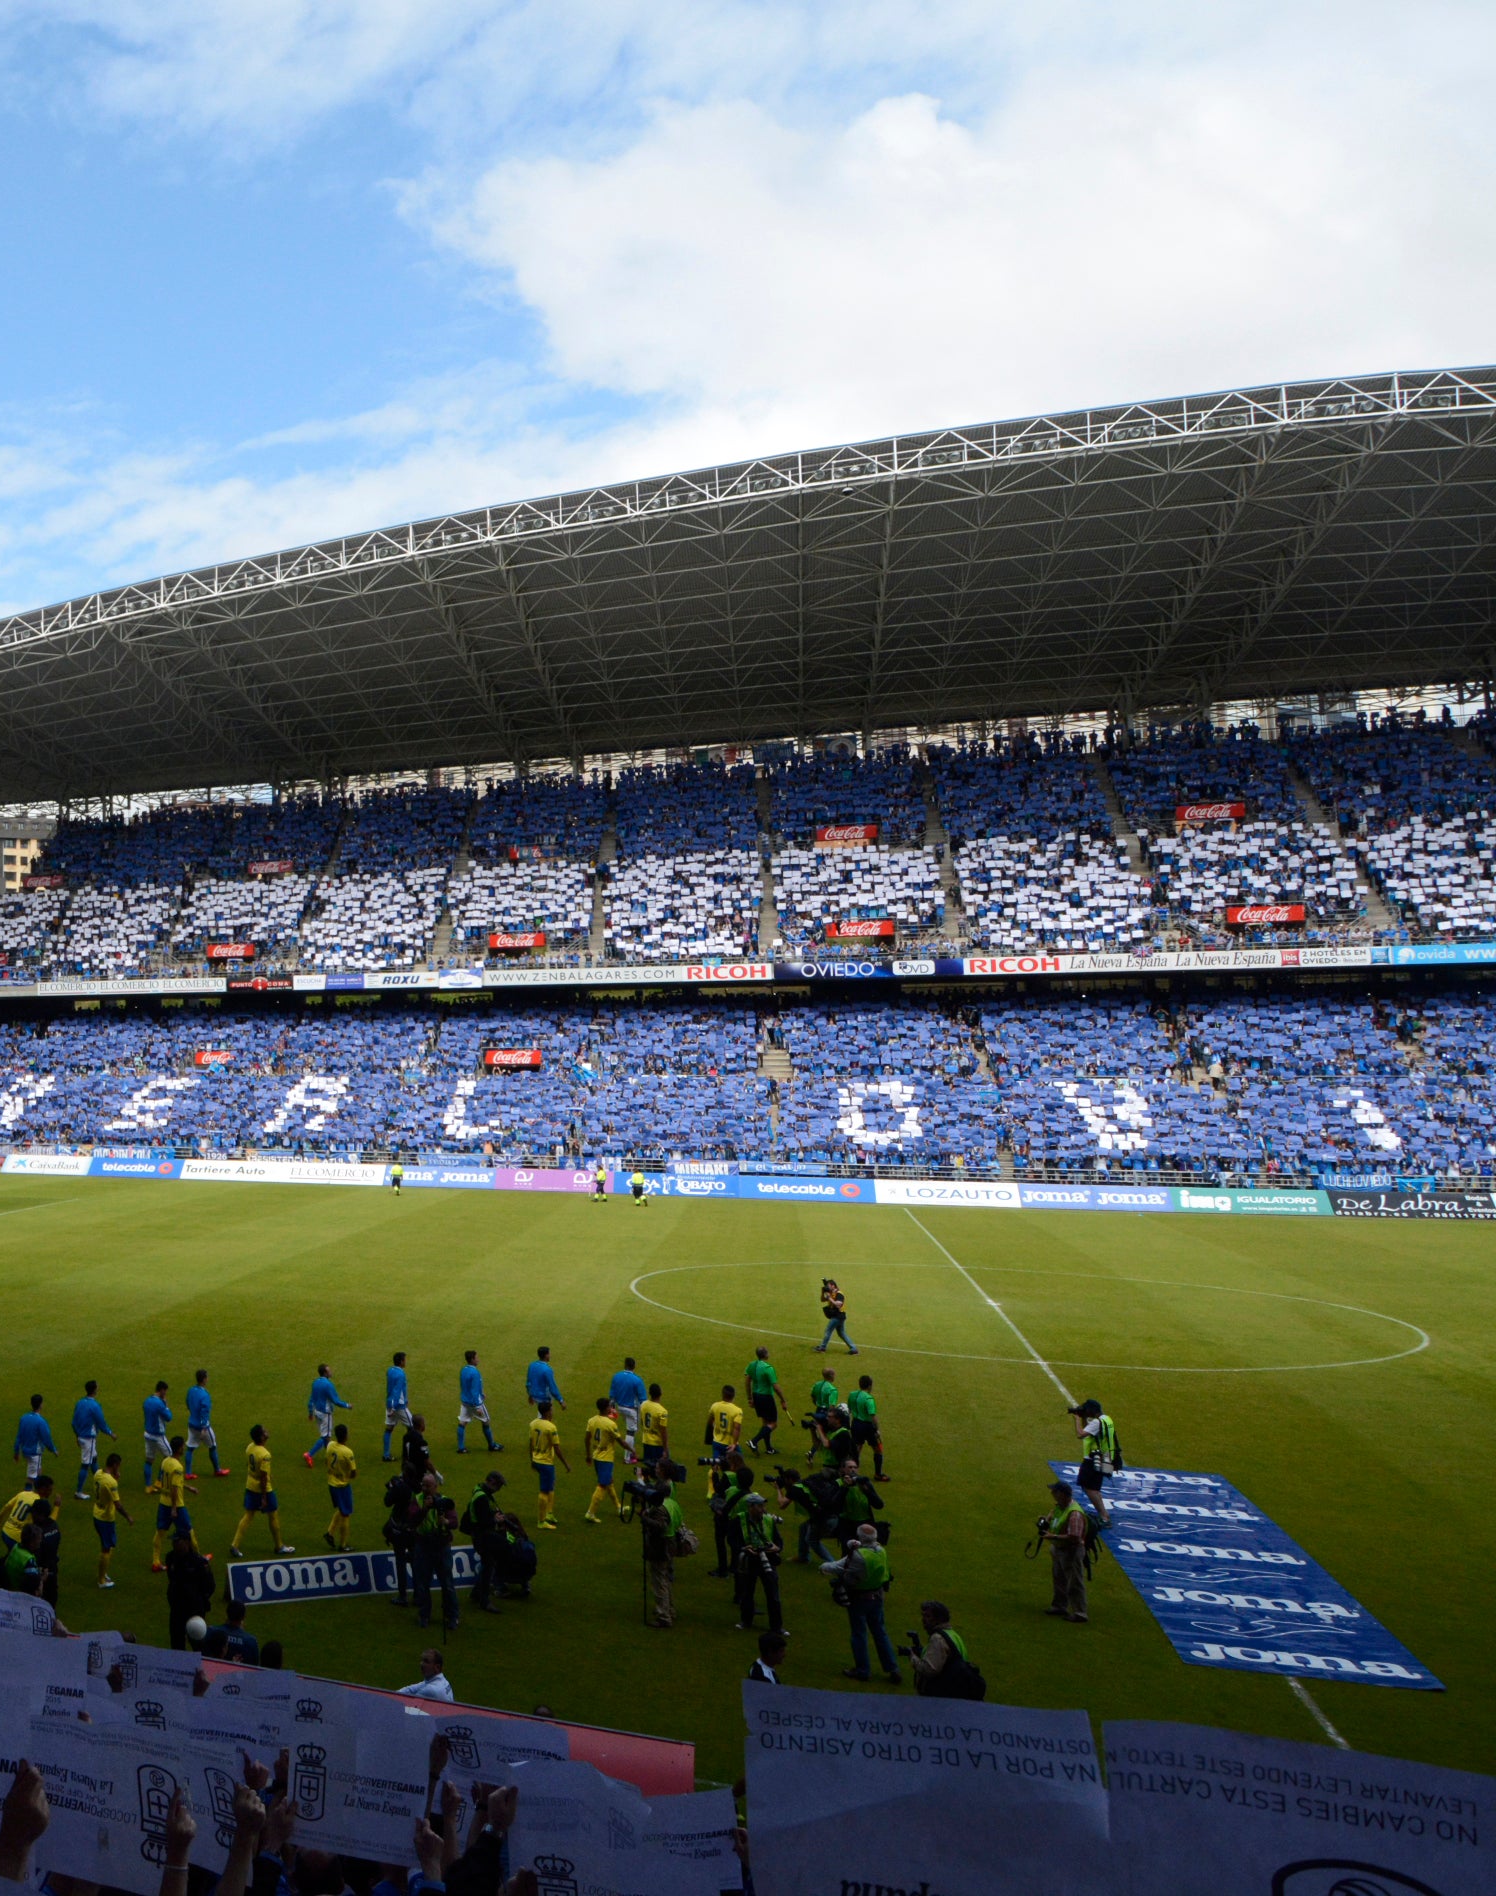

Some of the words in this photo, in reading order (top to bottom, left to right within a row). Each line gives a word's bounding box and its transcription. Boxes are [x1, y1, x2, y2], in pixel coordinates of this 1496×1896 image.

[1184, 804, 1238, 819] Coca-Cola
[824, 826, 868, 840] Coca-Cola
[1237, 906, 1292, 922] Coca-Cola
[496, 933, 536, 947] Coca-Cola
[213, 945, 246, 957] Coca-Cola
[1283, 952, 1298, 962] ibis
[1310, 949, 1352, 957] HOTELES
[1417, 947, 1455, 961] ovida
[969, 957, 1061, 973] RICOH
[1069, 956, 1085, 970] La
[1088, 955, 1122, 969] Nueva
[1126, 954, 1167, 970] España
[1175, 954, 1191, 967] La
[1194, 953, 1229, 967] Nueva
[1233, 952, 1276, 968] España
[1302, 957, 1338, 965] OVIEDO
[489, 968, 675, 982] WWW.ZENBALAGARES.COM
[686, 964, 767, 980] RICOH
[801, 962, 875, 978] OVIEDO
[39, 983, 49, 992] EL
[50, 982, 97, 992] COMERCIO
[100, 982, 111, 991] EL
[112, 981, 159, 991] COMERCIO
[162, 980, 173, 989] EL
[174, 979, 224, 989] COMERCIO
[382, 975, 420, 985] ROXU
[492, 1051, 533, 1065] Coca-Cola
[206, 1152, 227, 1161] 1926
[29, 1160, 81, 1171] CaixaBank
[102, 1163, 156, 1173] telecable
[185, 1164, 232, 1175] Tartiere
[236, 1166, 266, 1176] Auto
[290, 1168, 306, 1176] EL
[307, 1168, 375, 1178] COMERCIO
[758, 1182, 835, 1196] telecable
[905, 1187, 1012, 1201] LOZAUTO
[1237, 1195, 1316, 1205] IGUALATORIO
[1337, 1198, 1372, 1210] De
[1378, 1193, 1464, 1212] Labra
[1335, 1210, 1409, 1218] delabra.es
[644, 1415, 651, 1428] 6
[719, 1412, 728, 1428] 5
[535, 1429, 543, 1442] 7
[594, 1428, 601, 1442] 4
[248, 1453, 256, 1467] 9
[330, 1453, 339, 1465] 2
[11, 1499, 33, 1522] 10
[758, 1709, 826, 1730] CÉSPED
[831, 1716, 852, 1731] AL
[857, 1719, 904, 1737] CARA
[908, 1723, 955, 1741] OTRA
[960, 1725, 984, 1743] LA
[760, 1731, 854, 1756] ASIENTO
[861, 1741, 922, 1763] OTRO
[930, 1746, 960, 1767] DE
[1122, 1746, 1187, 1768] TEXTO,
[968, 1750, 998, 1772] LA
[1006, 1756, 1055, 1779] POR
[1193, 1752, 1245, 1778] ESTE
[33, 1762, 69, 1784] España
[1063, 1761, 1097, 1783] NA
[1252, 1763, 1352, 1796] LEYENDO
[70, 1771, 97, 1792] Nueva
[99, 1780, 115, 1795] La
[344, 1794, 356, 1807] La
[356, 1797, 382, 1813] Nueva
[382, 1800, 411, 1818] España
[1221, 1783, 1287, 1814] ESTA
[1360, 1782, 1478, 1818] LEVANTAR
[1298, 1797, 1426, 1836] CAMBIES
[1435, 1819, 1478, 1847] NO
